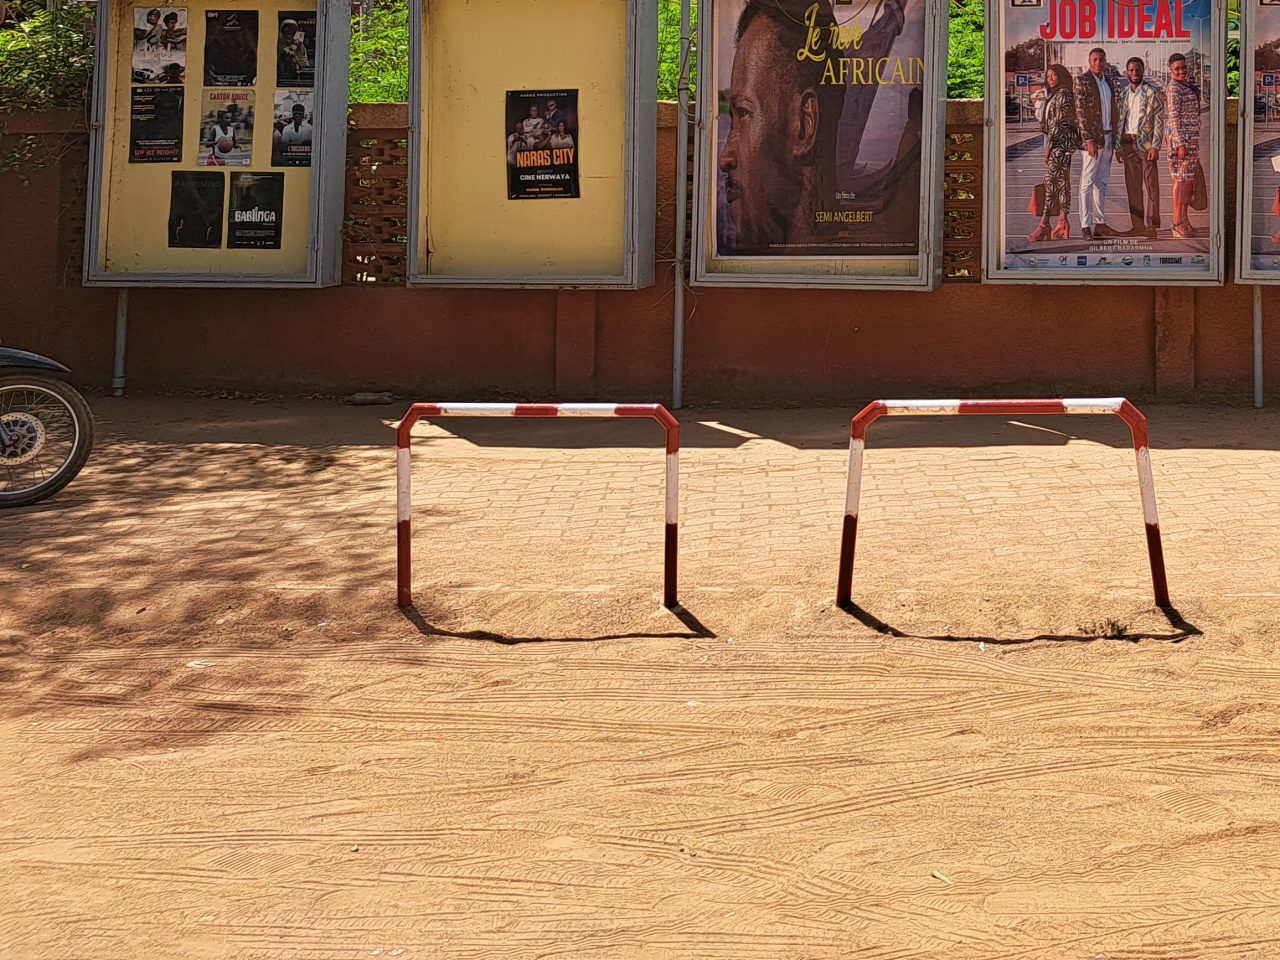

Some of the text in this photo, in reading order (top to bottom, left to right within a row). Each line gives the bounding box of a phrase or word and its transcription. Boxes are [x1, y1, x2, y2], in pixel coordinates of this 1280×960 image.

[796, 2, 827, 62] Le
[820, 57, 926, 85] AFRICAIN
[516, 147, 576, 168] NARAS CITY
[815, 211, 874, 223] SEMI ANGELBERT
